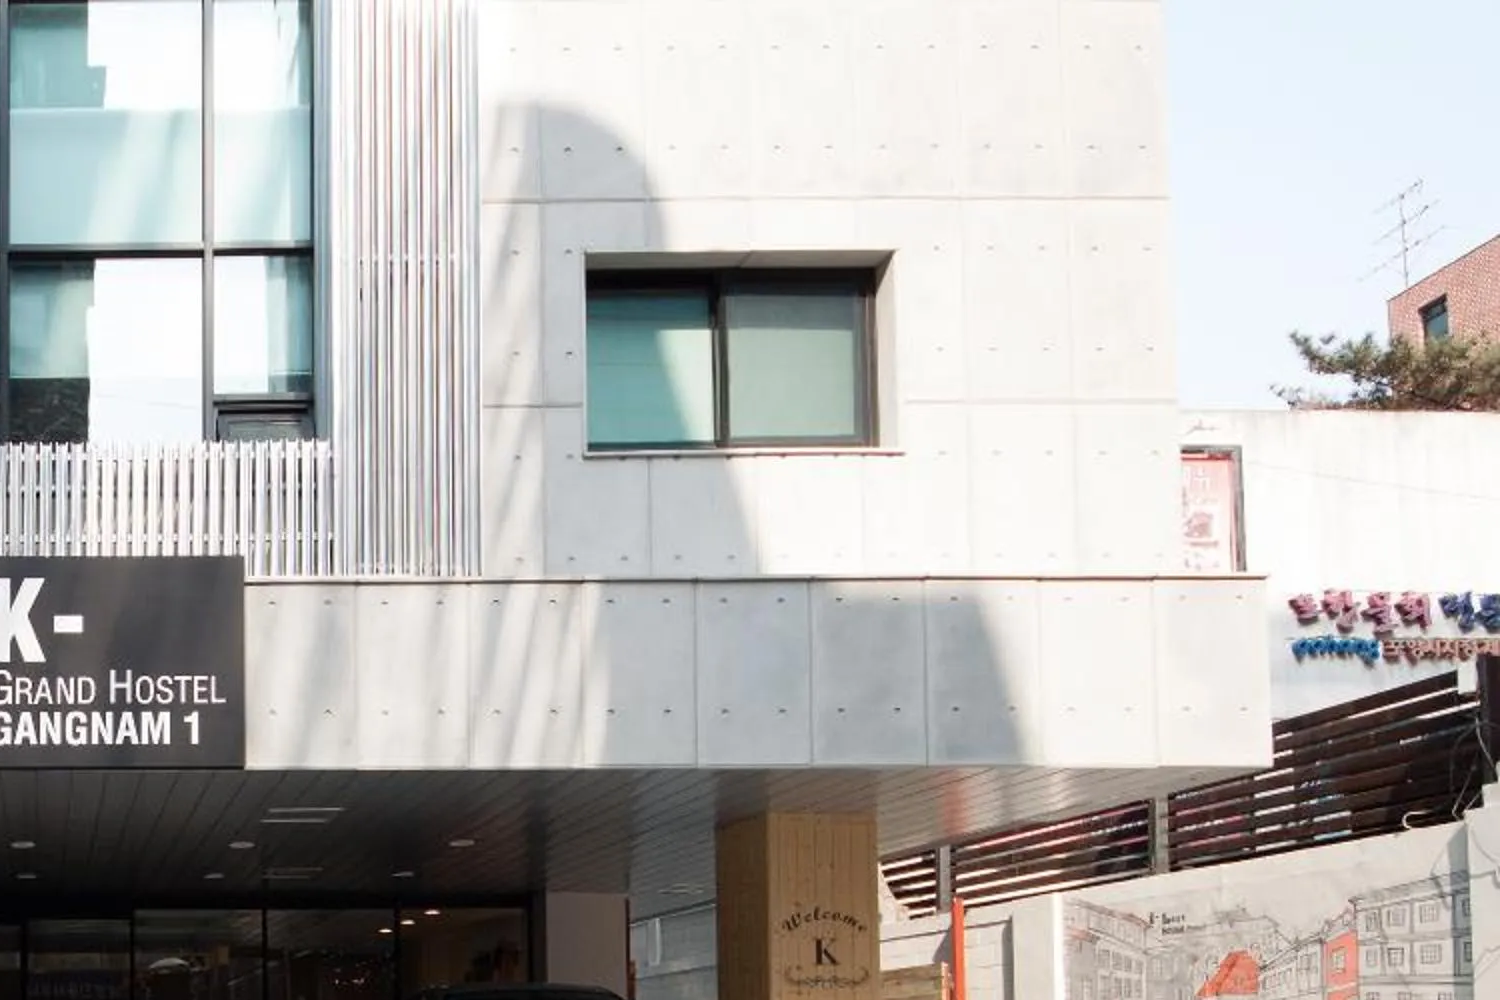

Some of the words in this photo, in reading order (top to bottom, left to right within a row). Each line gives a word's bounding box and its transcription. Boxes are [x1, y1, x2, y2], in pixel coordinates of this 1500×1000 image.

[183, 711, 200, 745] 1
[781, 906, 868, 932] Welcome
[813, 938, 841, 965] K
